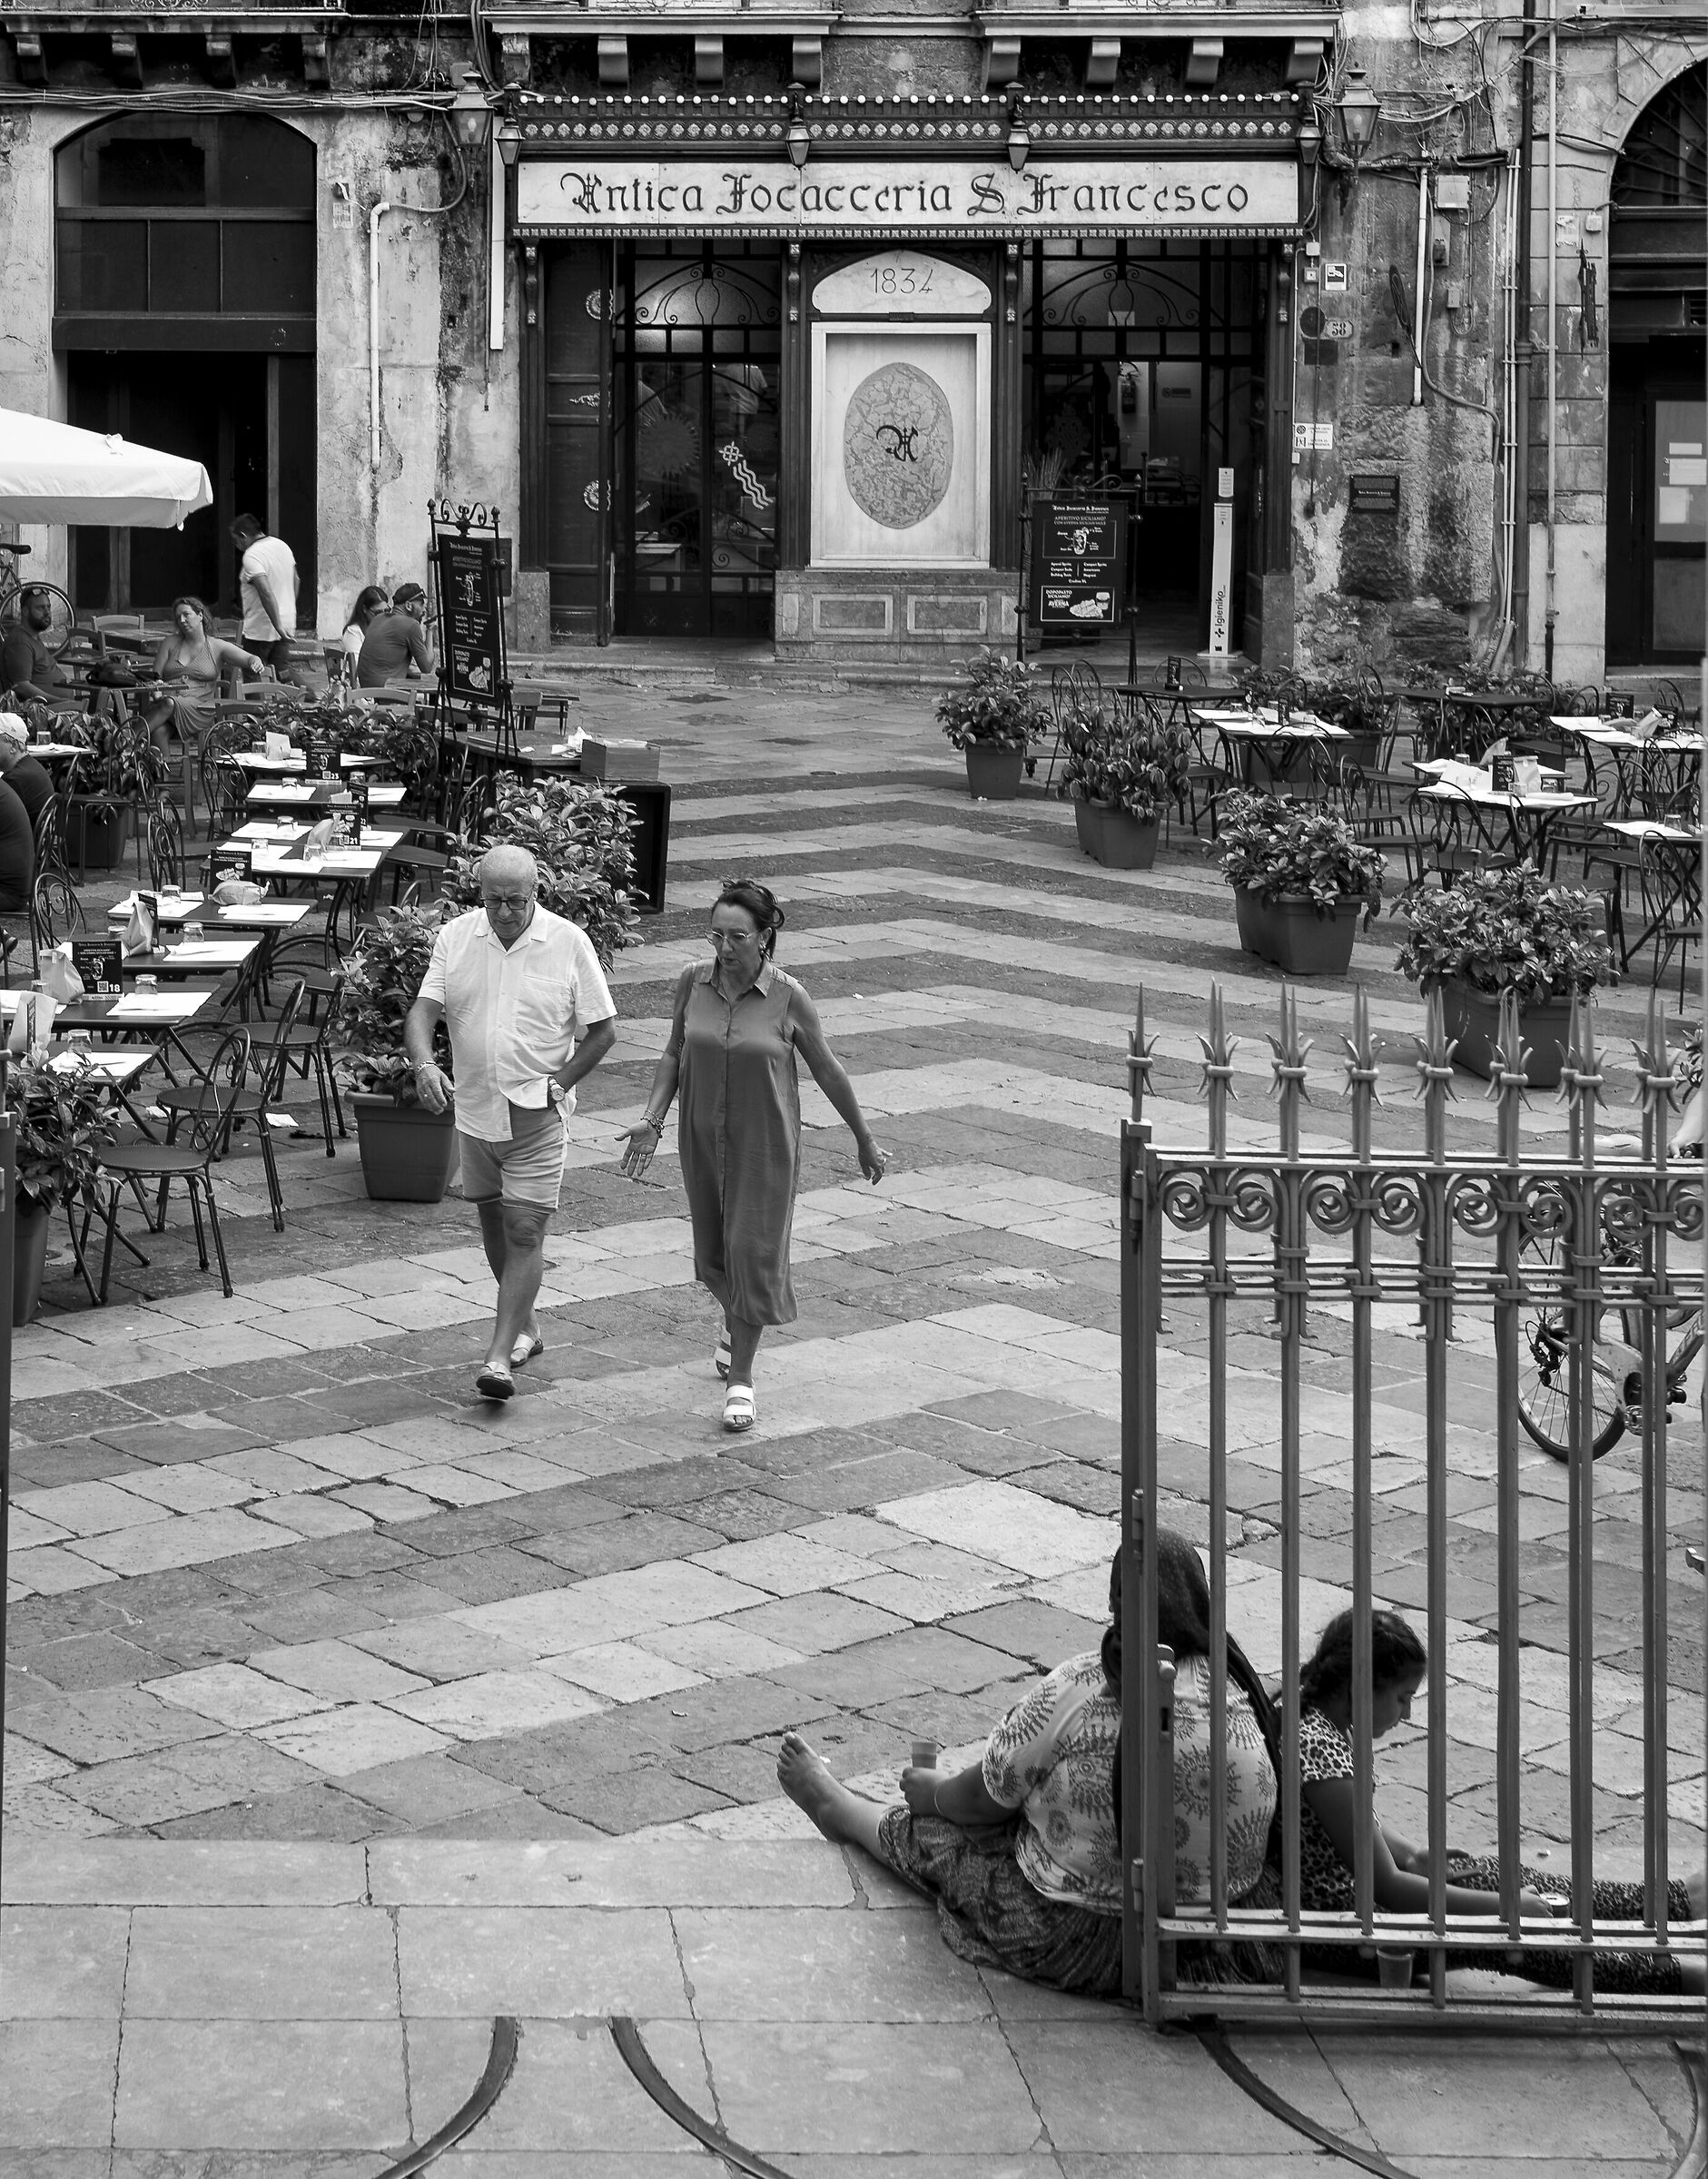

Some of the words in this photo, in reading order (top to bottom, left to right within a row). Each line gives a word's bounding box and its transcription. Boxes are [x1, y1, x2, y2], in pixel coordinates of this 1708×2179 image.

[559, 172, 704, 214] Antica
[716, 173, 952, 215] Focacceria
[966, 173, 1006, 216] S.
[1016, 173, 1249, 216] Francesco
[869, 267, 933, 294] 1834
[1331, 322, 1347, 336] 58
[1214, 590, 1226, 626] Igieniko
[349, 837, 358, 845] 21
[109, 983, 121, 993] 18
